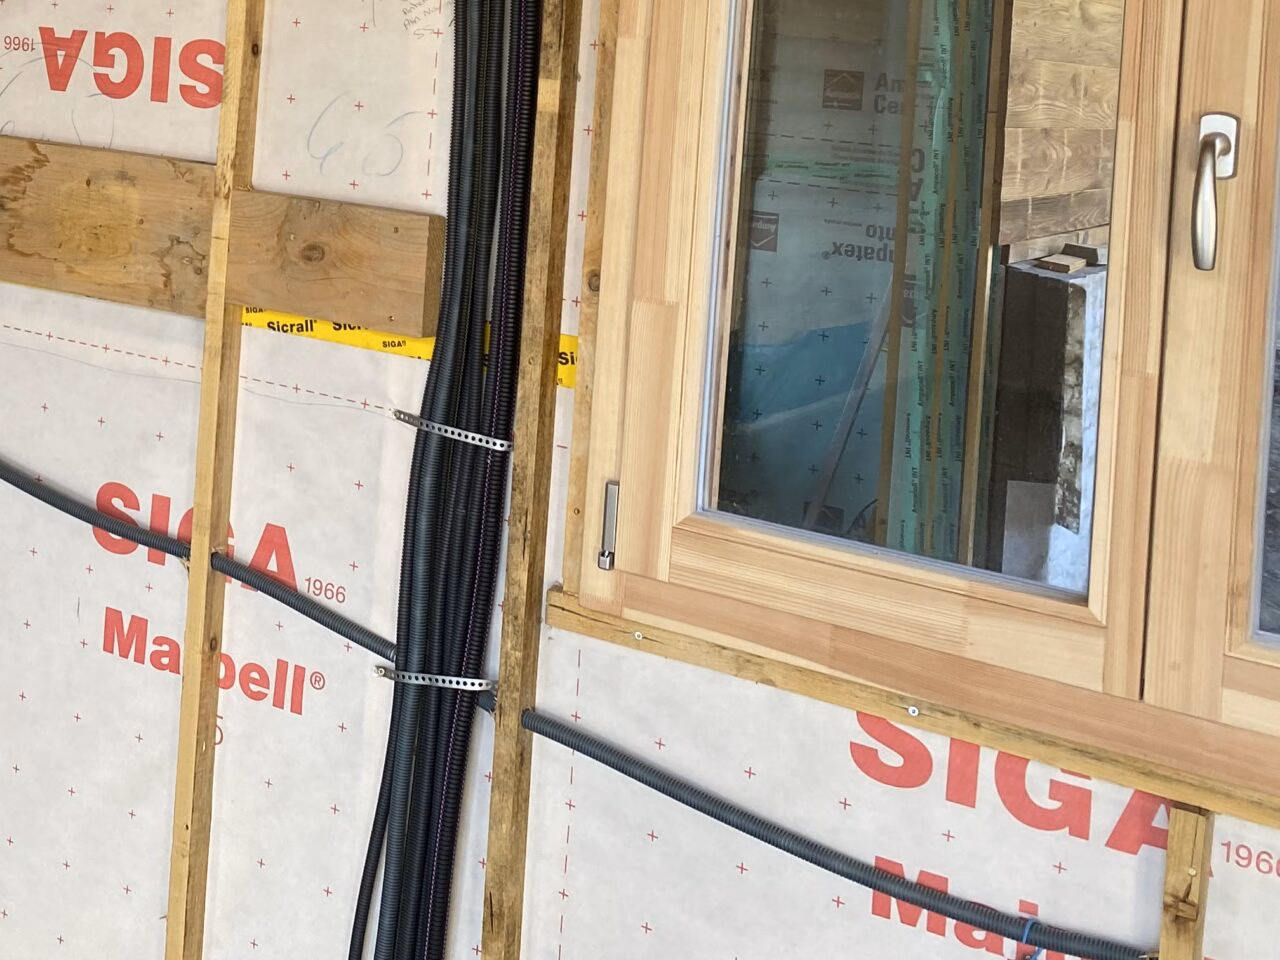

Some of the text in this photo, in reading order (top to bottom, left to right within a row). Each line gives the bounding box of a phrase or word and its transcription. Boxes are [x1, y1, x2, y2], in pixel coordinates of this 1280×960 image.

[4, 26, 226, 109] SIGA 1966
[304, 577, 347, 603] 1966
